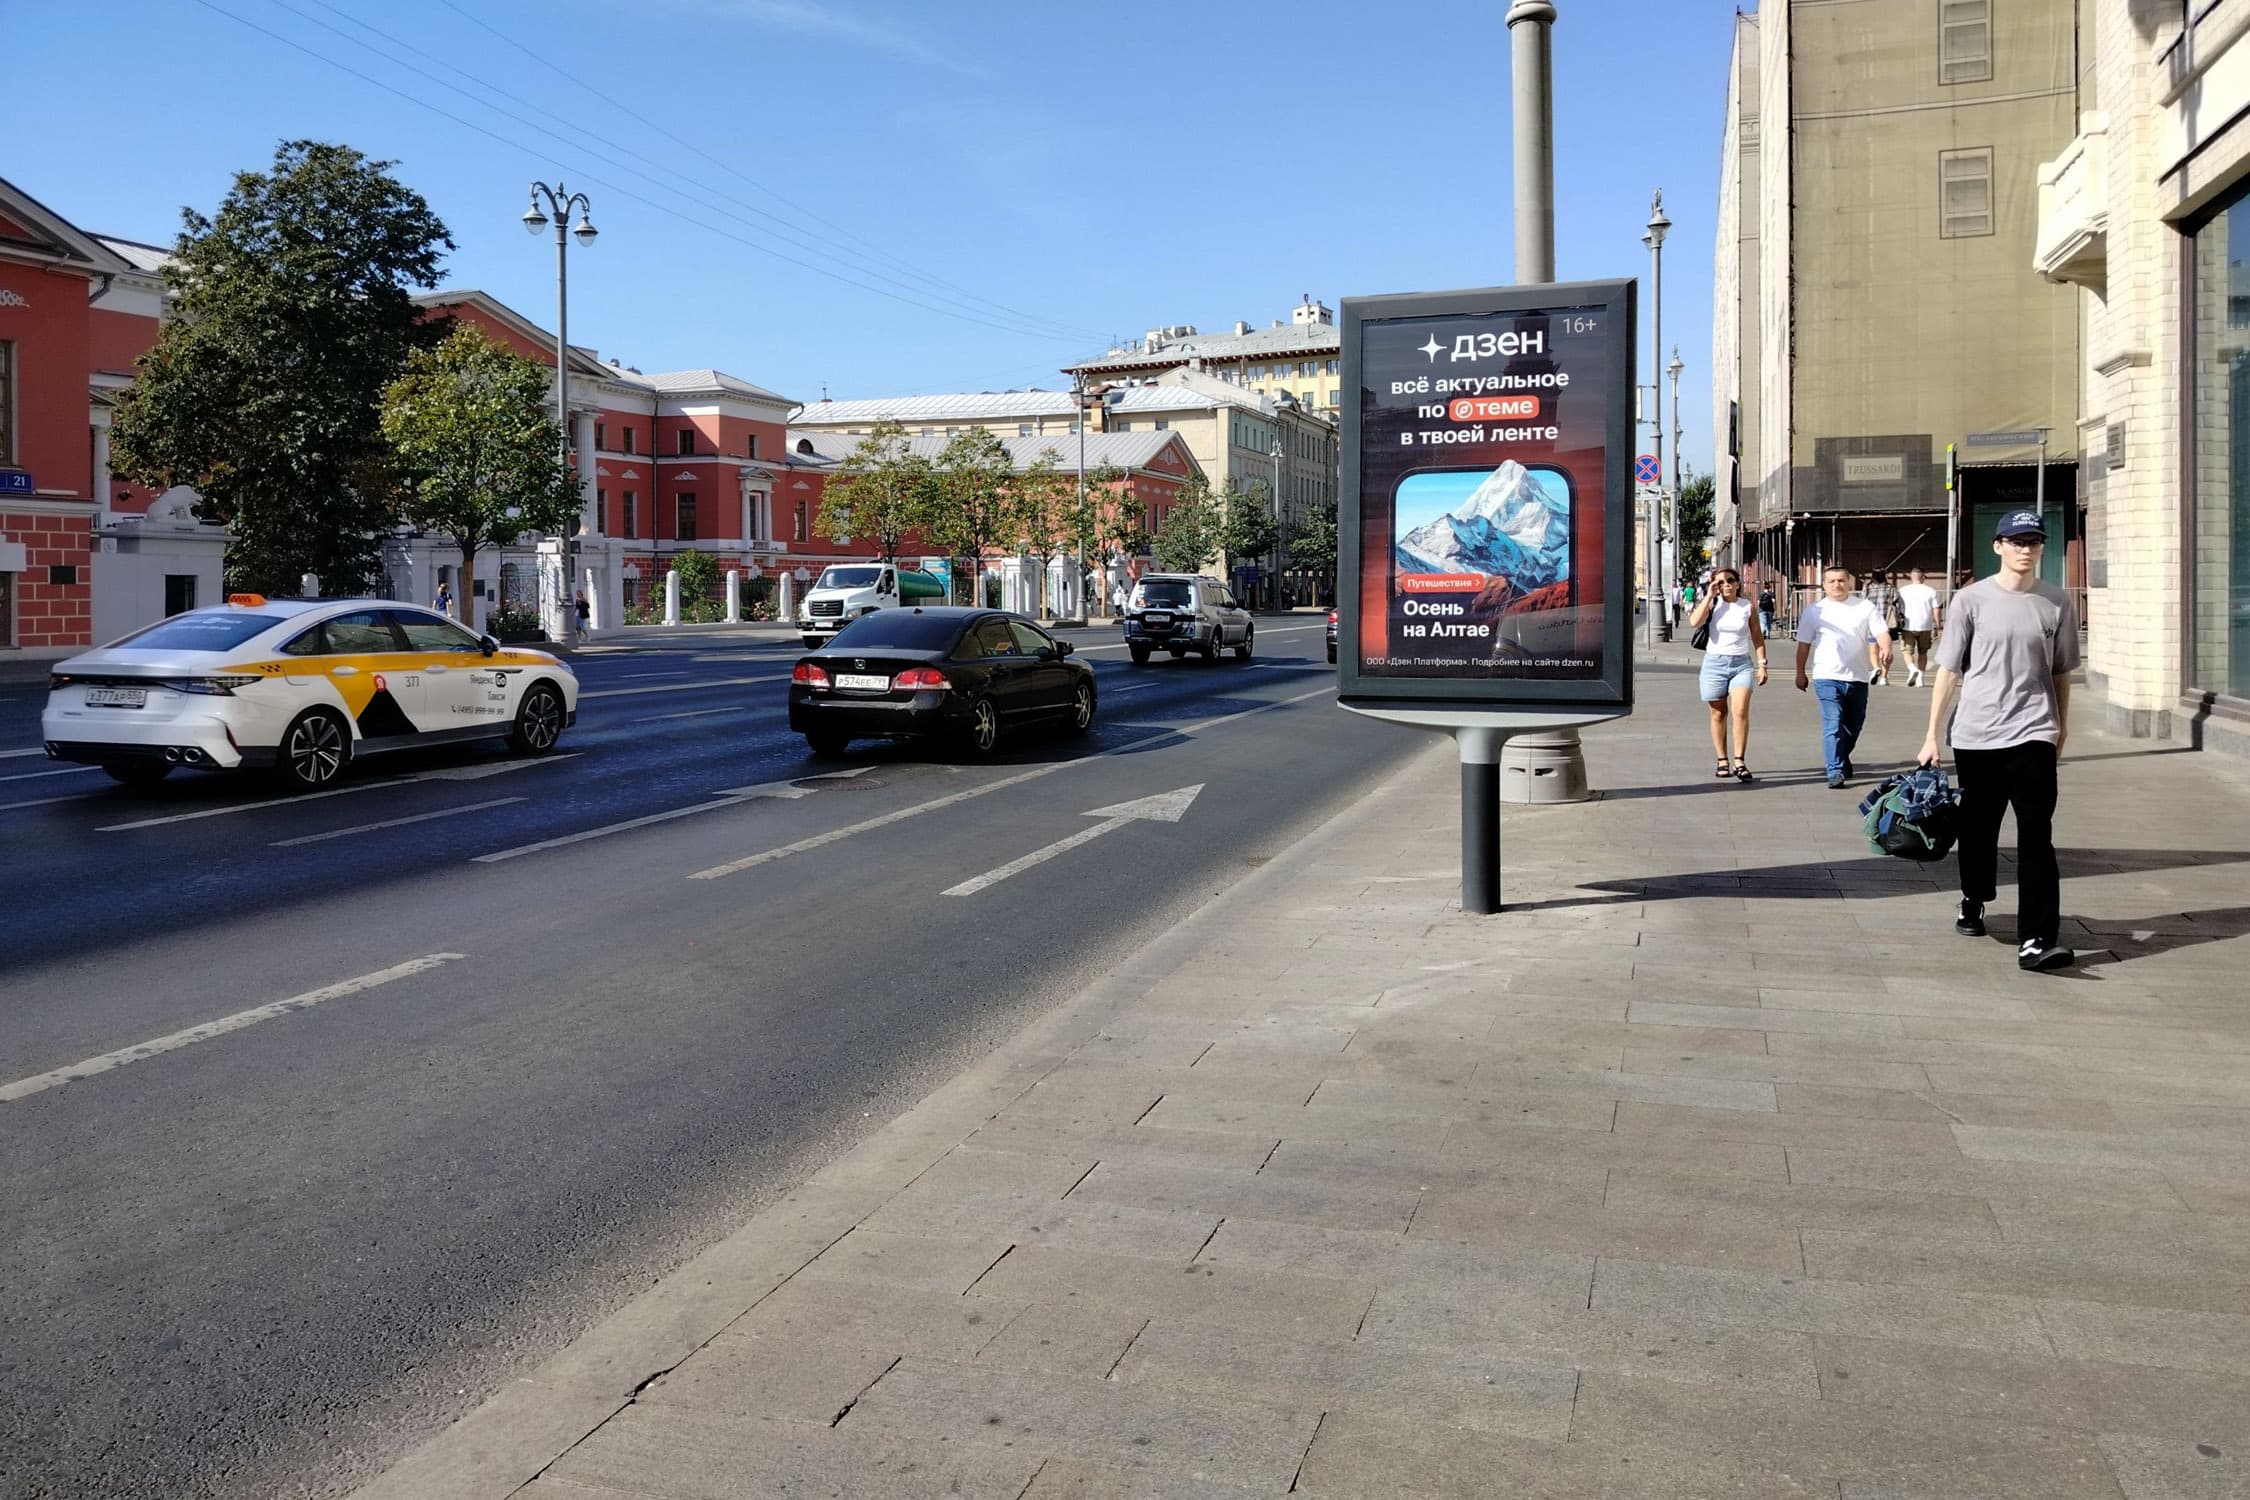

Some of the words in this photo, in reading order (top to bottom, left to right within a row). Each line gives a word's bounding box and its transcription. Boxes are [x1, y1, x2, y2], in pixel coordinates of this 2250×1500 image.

[1562, 316, 1597, 335] 16+
[1391, 376, 1430, 395] всё
[1435, 372, 1570, 396] актуальное
[1418, 403, 1446, 420] по
[1476, 400, 1534, 417] теме
[1400, 432, 1413, 446] в
[1419, 424, 1485, 445] твоей
[1490, 424, 1560, 443] ленте
[13, 475, 25, 487] 21
[1407, 578, 1473, 590] Путешествия
[1403, 600, 1465, 616] Осень
[1403, 624, 1427, 638] на
[1430, 621, 1491, 638] Алтае
[1366, 657, 1385, 666] ООО
[1471, 657, 1520, 668] Подробнее
[1521, 659, 1533, 667] на
[1534, 657, 1561, 667] сайте
[1561, 657, 1594, 668] dzen.ru
[405, 675, 420, 688] 377
